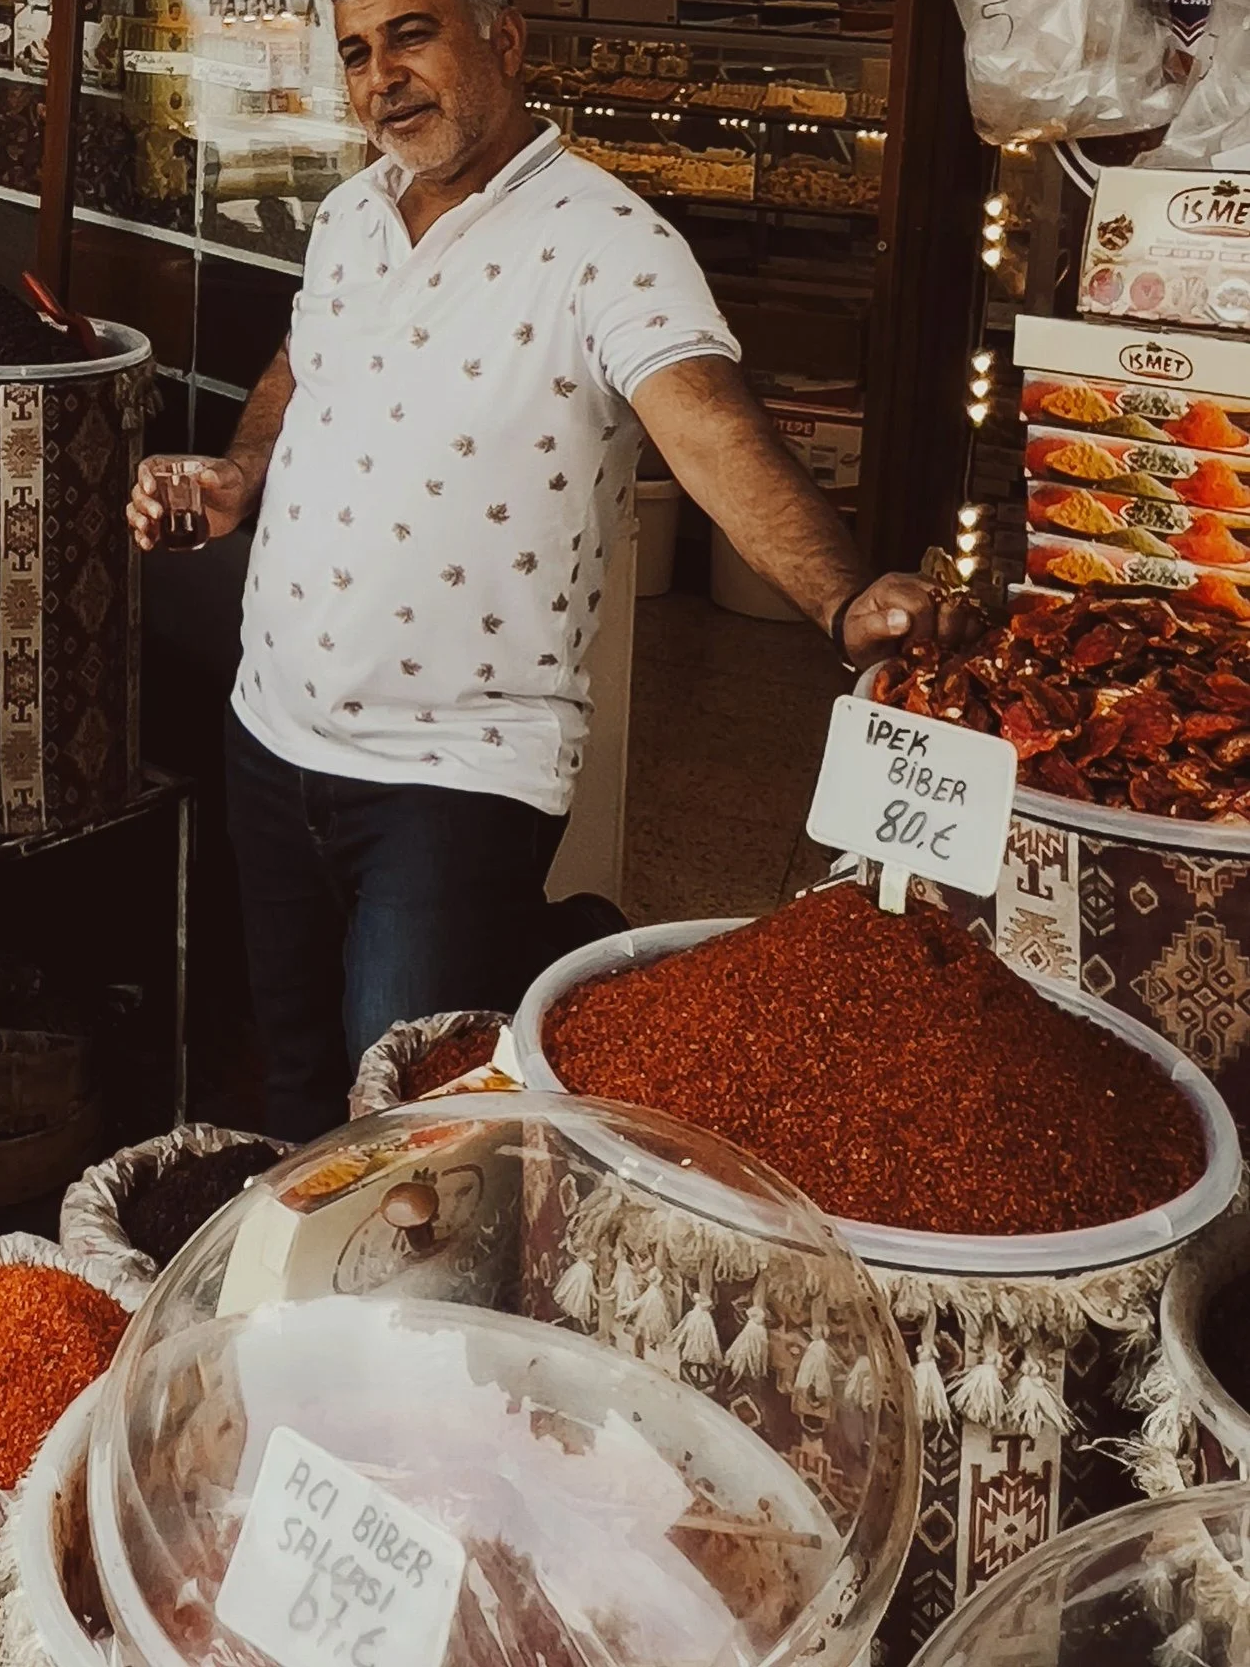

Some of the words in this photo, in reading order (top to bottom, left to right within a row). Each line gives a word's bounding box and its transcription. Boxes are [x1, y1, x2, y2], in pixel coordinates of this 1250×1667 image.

[865, 712, 930, 757] İPEK
[887, 757, 968, 806] BİBER
[283, 1457, 339, 1520] ACI
[351, 1505, 433, 1589] BİBER
